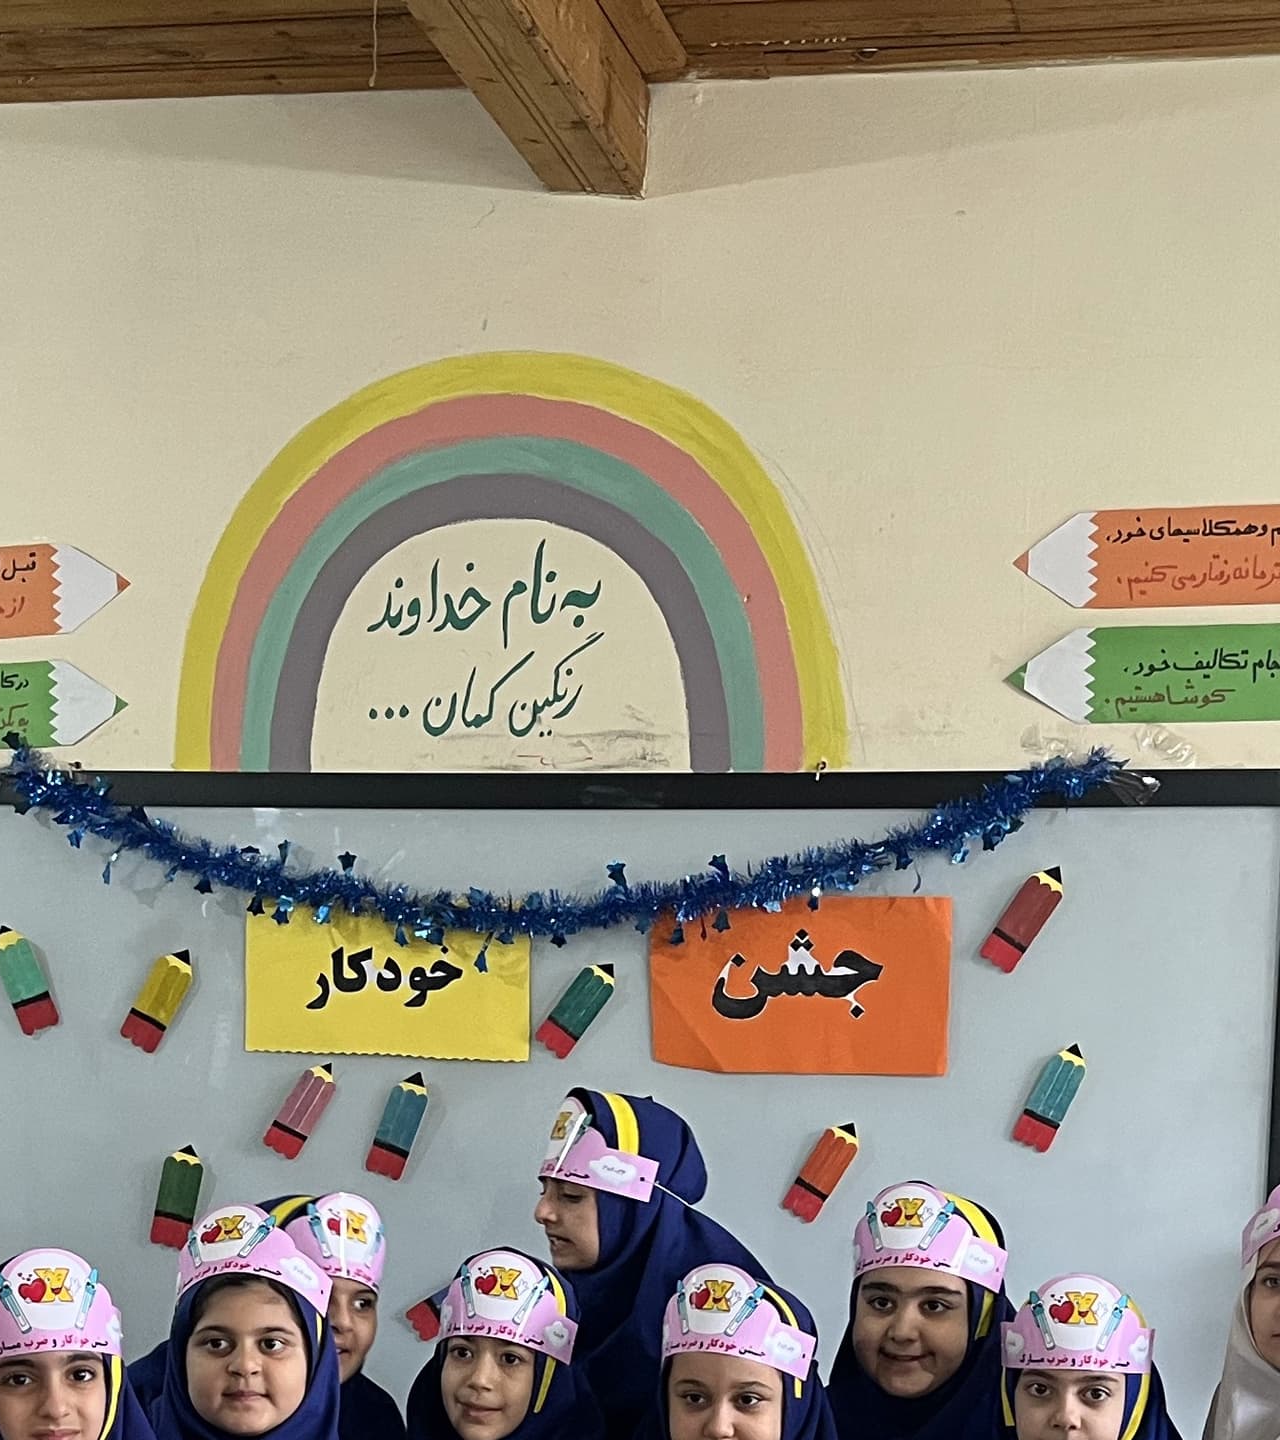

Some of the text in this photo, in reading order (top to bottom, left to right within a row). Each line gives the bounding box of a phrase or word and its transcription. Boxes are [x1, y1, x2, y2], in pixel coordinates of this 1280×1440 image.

[1256, 524, 1267, 538] و
[3, 552, 37, 582] قبل
[1196, 555, 1233, 588] رفتار
[1170, 567, 1196, 589] می
[366, 538, 601, 650] به نام خداوند
[9, 597, 25, 618] از
[1173, 647, 1249, 678] تکالیف
[422, 650, 535, 737] کمان
[508, 632, 604, 738] رنگین
[306, 927, 884, 1021] جشن خودکار
[219, 1260, 251, 1272] خودکار
[901, 1253, 930, 1265] خودکار
[487, 1326, 492, 1334] و
[52, 1339, 57, 1348] و
[706, 1337, 736, 1352] خودکار
[1047, 1354, 1068, 1366] ضرب
[1070, 1357, 1076, 1367] و
